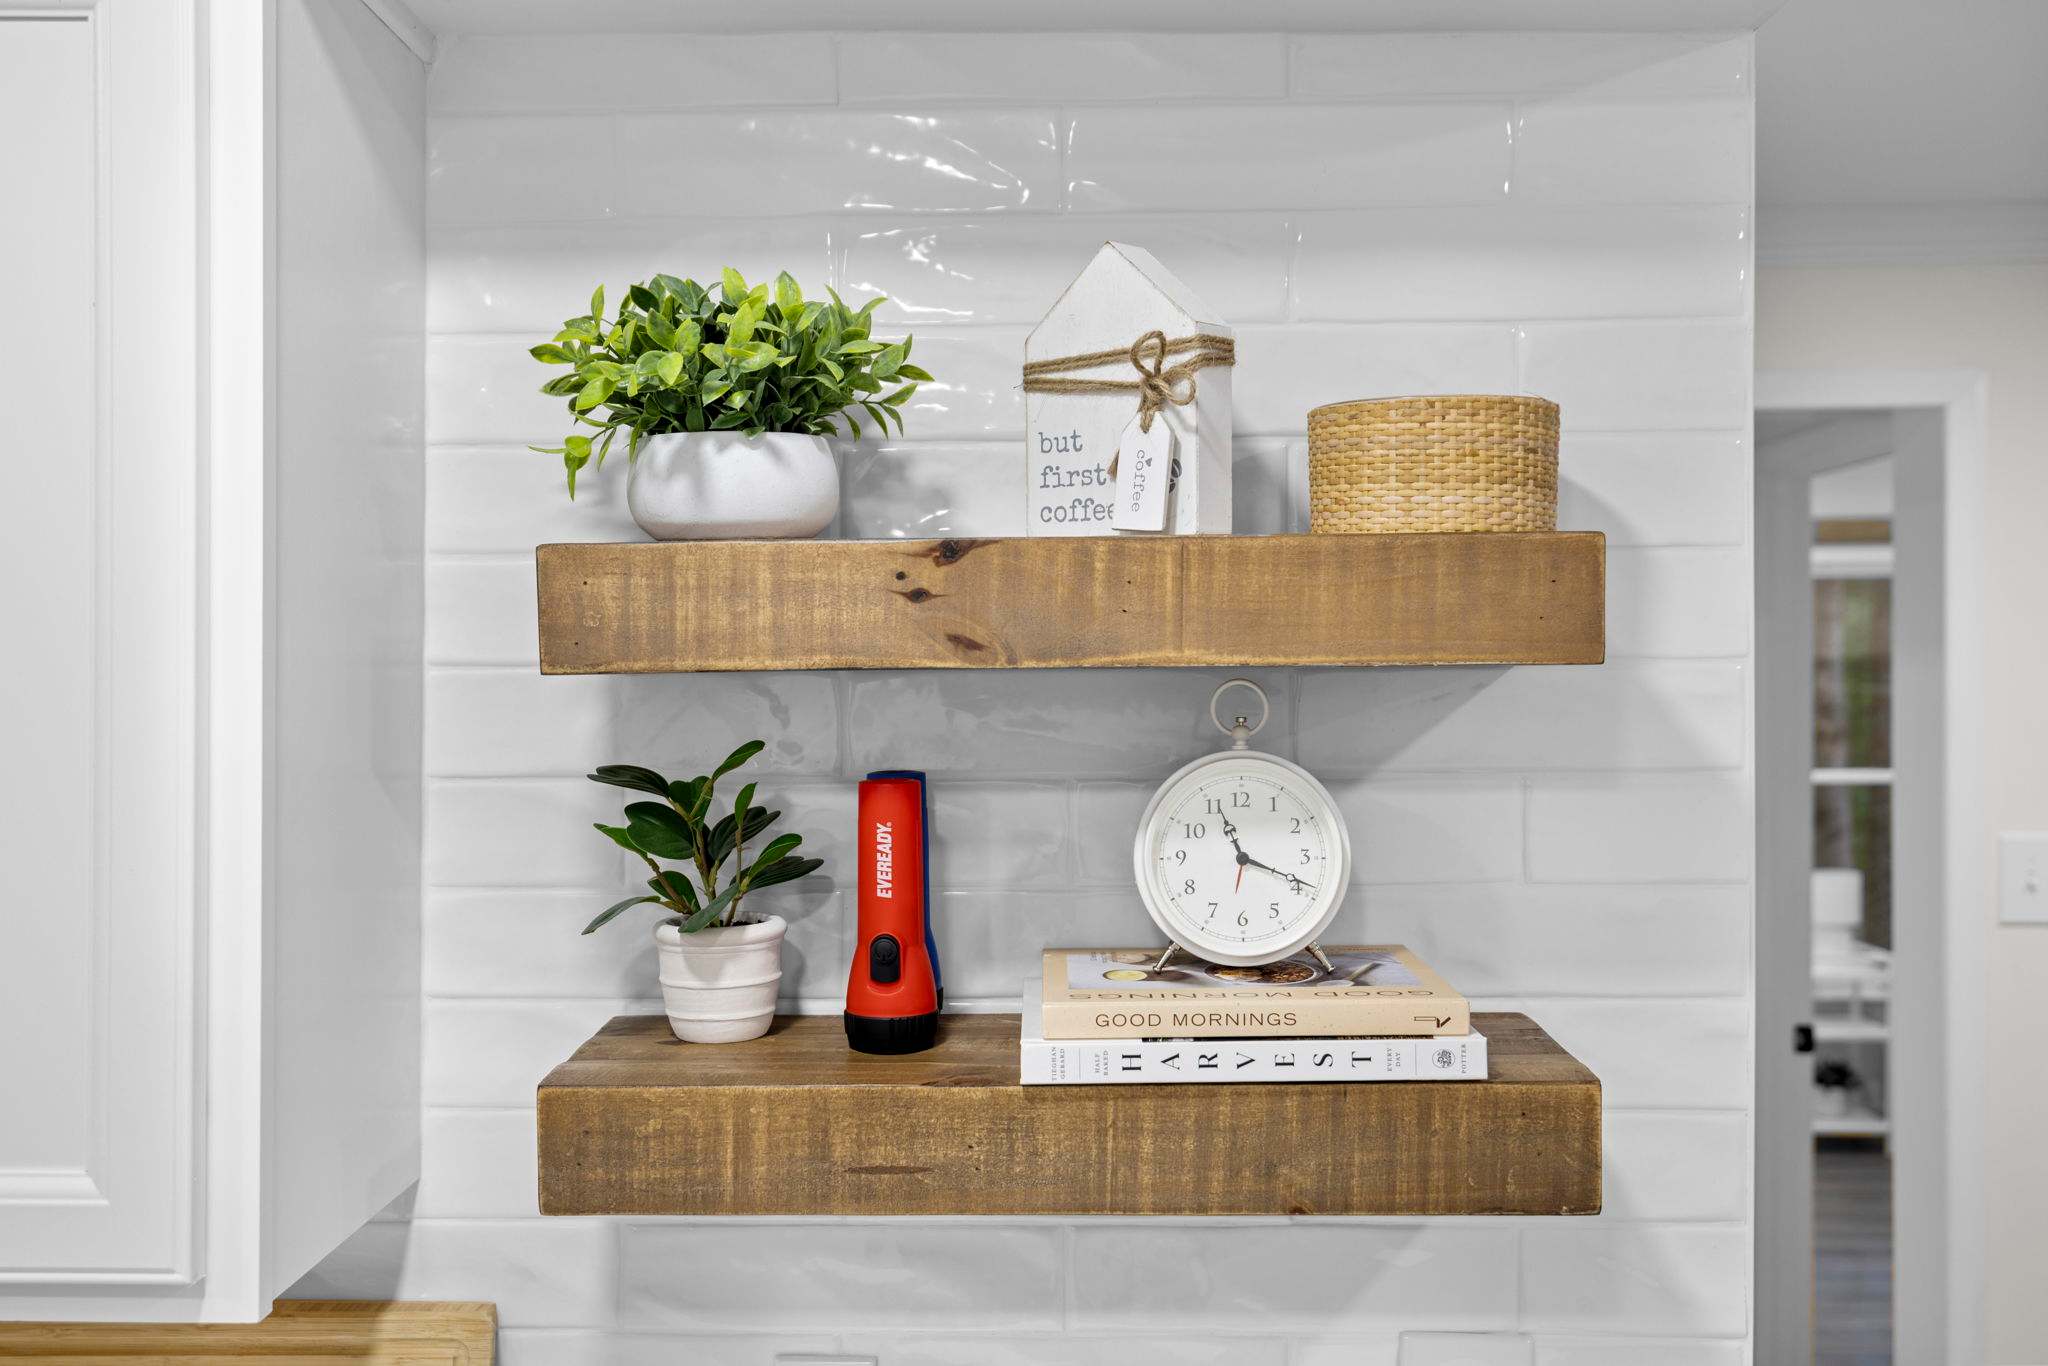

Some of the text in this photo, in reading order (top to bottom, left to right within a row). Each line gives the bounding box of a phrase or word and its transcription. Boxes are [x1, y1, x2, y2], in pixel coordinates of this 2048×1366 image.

[1038, 430, 1083, 453] but
[1040, 463, 1107, 488] first
[1132, 449, 1146, 512] coffee
[1204, 798, 1221, 814] 11
[1231, 792, 1251, 808] 12
[1269, 796, 1277, 812] 1
[1184, 823, 1205, 838] 10
[1290, 817, 1301, 833] 2
[877, 823, 892, 898] EVEREADY
[1175, 849, 1187, 866] 9
[1300, 848, 1310, 864] 3
[1184, 879, 1195, 895] 8
[1289, 879, 1303, 895] 4
[1208, 902, 1218, 918] 7
[1269, 902, 1280, 919] 5
[1237, 910, 1249, 927] 6
[1069, 990, 1434, 999] GOOD MORNINGS
[1095, 1012, 1297, 1028] GOOD MORNINGS
[1122, 1052, 1372, 1071] HARVEST
